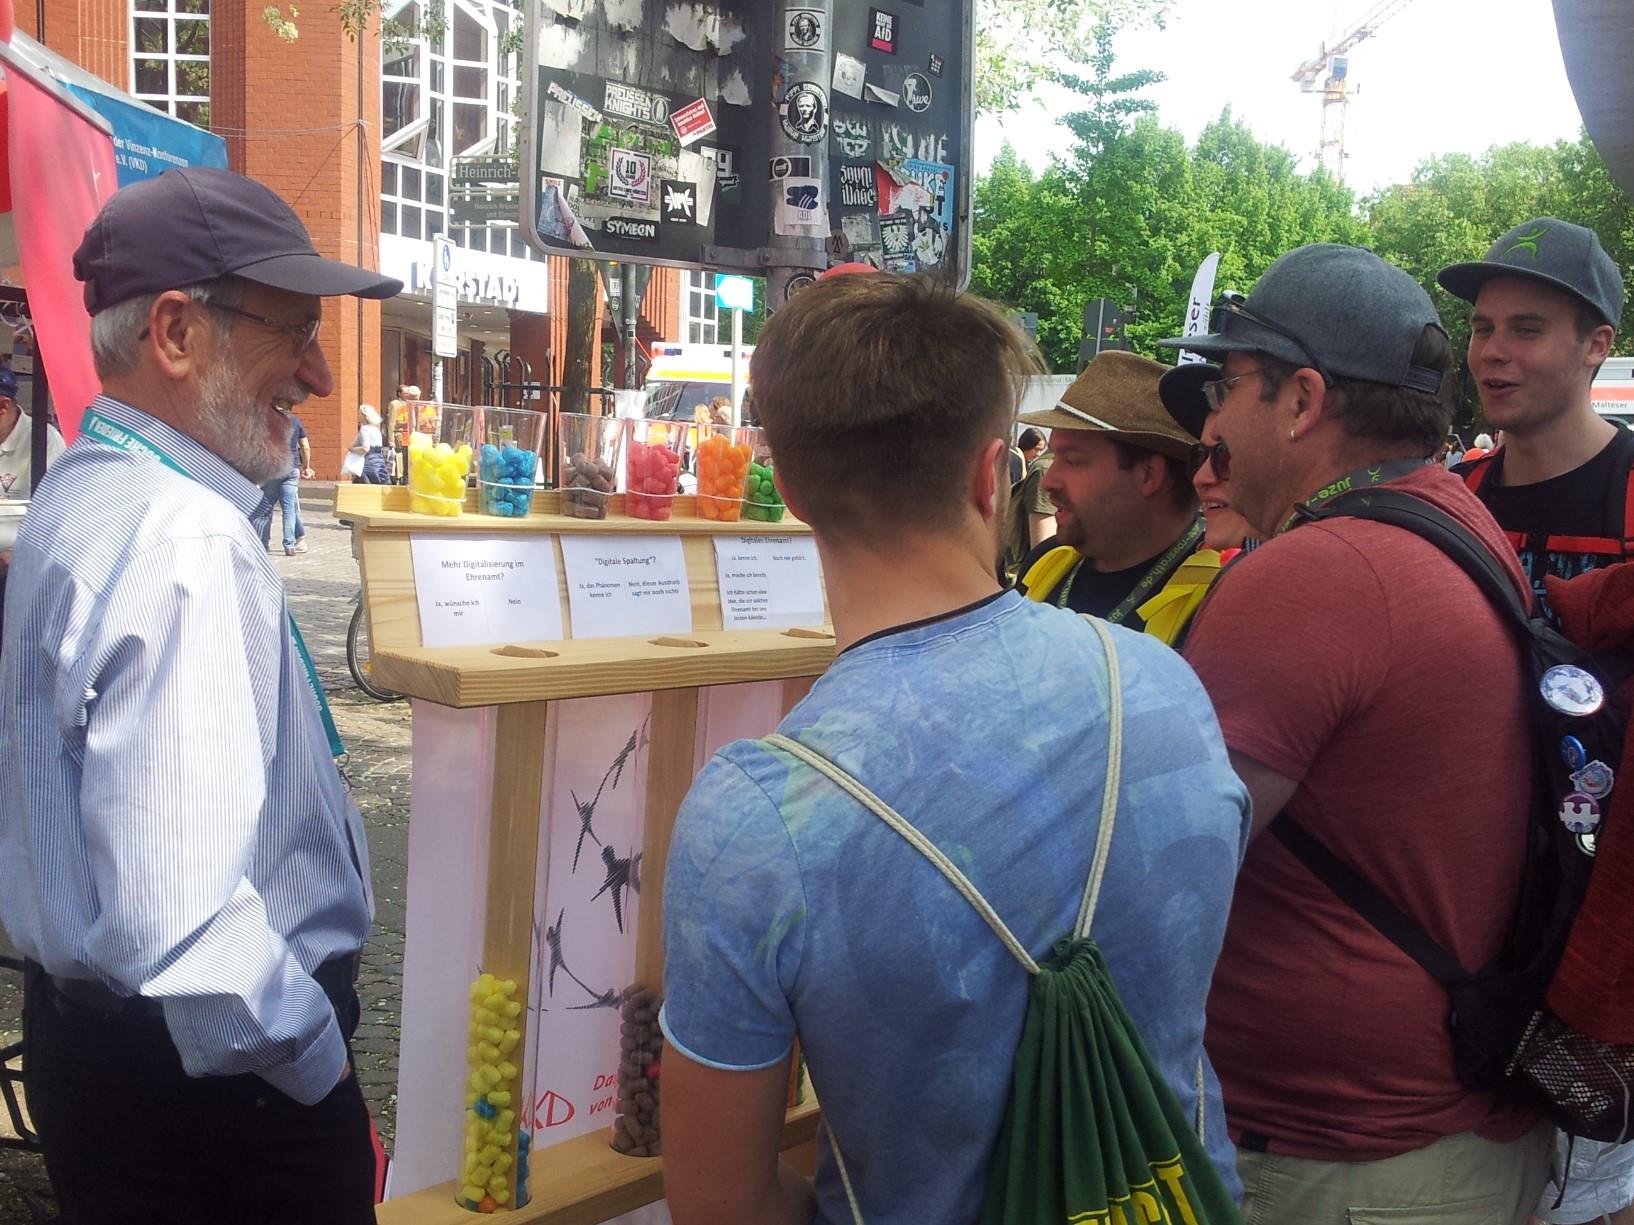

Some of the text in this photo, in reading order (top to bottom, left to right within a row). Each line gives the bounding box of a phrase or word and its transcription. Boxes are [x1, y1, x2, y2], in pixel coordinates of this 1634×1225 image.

[874, 25, 892, 42] AfD
[606, 84, 651, 109] PREUSSEN
[605, 97, 650, 120] KNIGHTS
[128, 156, 148, 174] (VKD)
[460, 165, 520, 178] Heinrich-
[625, 160, 637, 174] 10
[441, 559, 524, 569] Mehr Digitalisierung im
[595, 555, 656, 567] "Digitale Spaltung"?
[465, 572, 504, 581] Ehrenamt?
[592, 1074, 617, 1091] Da
[588, 1096, 613, 1116] von
